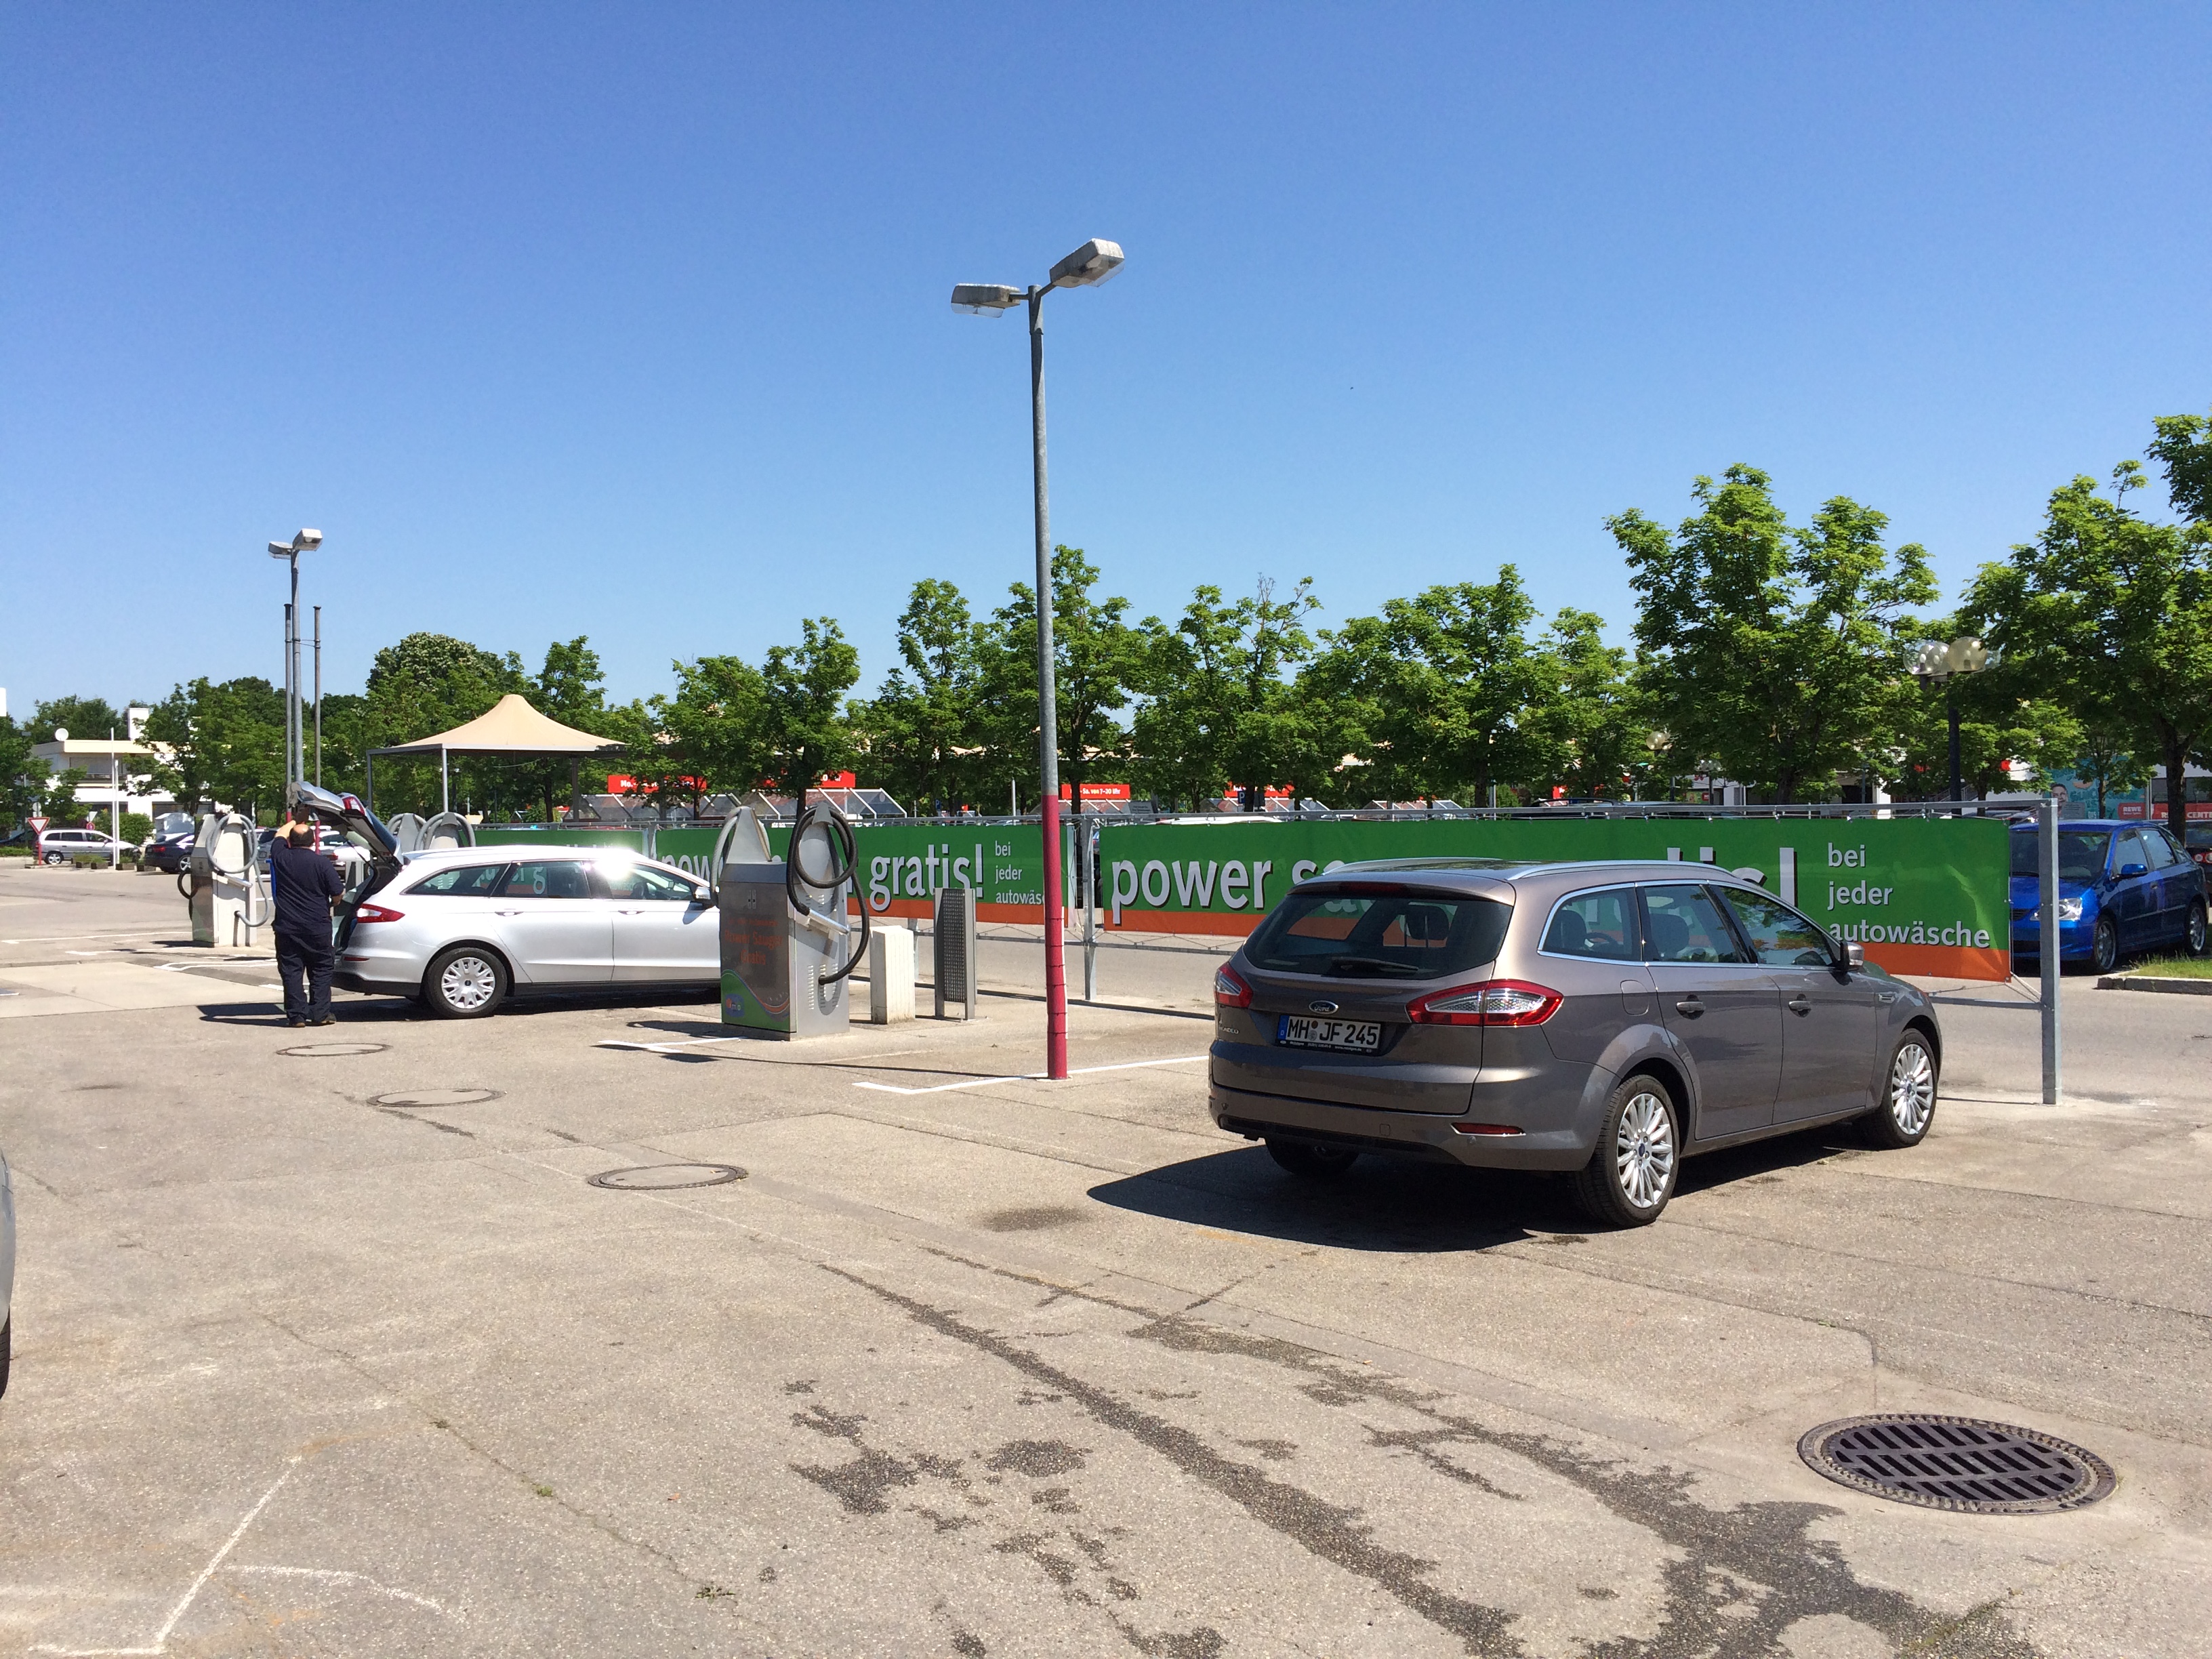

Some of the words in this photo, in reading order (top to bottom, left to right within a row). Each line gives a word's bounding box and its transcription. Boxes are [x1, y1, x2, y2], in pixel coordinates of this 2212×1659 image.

[1239, 792, 1245, 802] P
[995, 840, 1011, 856] bei
[1828, 842, 1866, 867] bei
[869, 844, 983, 912] gratis!
[995, 864, 1022, 884] jeder
[996, 889, 1044, 905] autowäs
[1111, 860, 1272, 924] power
[1827, 880, 1893, 910] jeder
[1830, 920, 1990, 948] autowäsche
[740, 949, 766, 966] Gratis
[1288, 1019, 1310, 1039] MH
[1319, 1022, 1343, 1041] JF
[1344, 1024, 1378, 1046] 245
